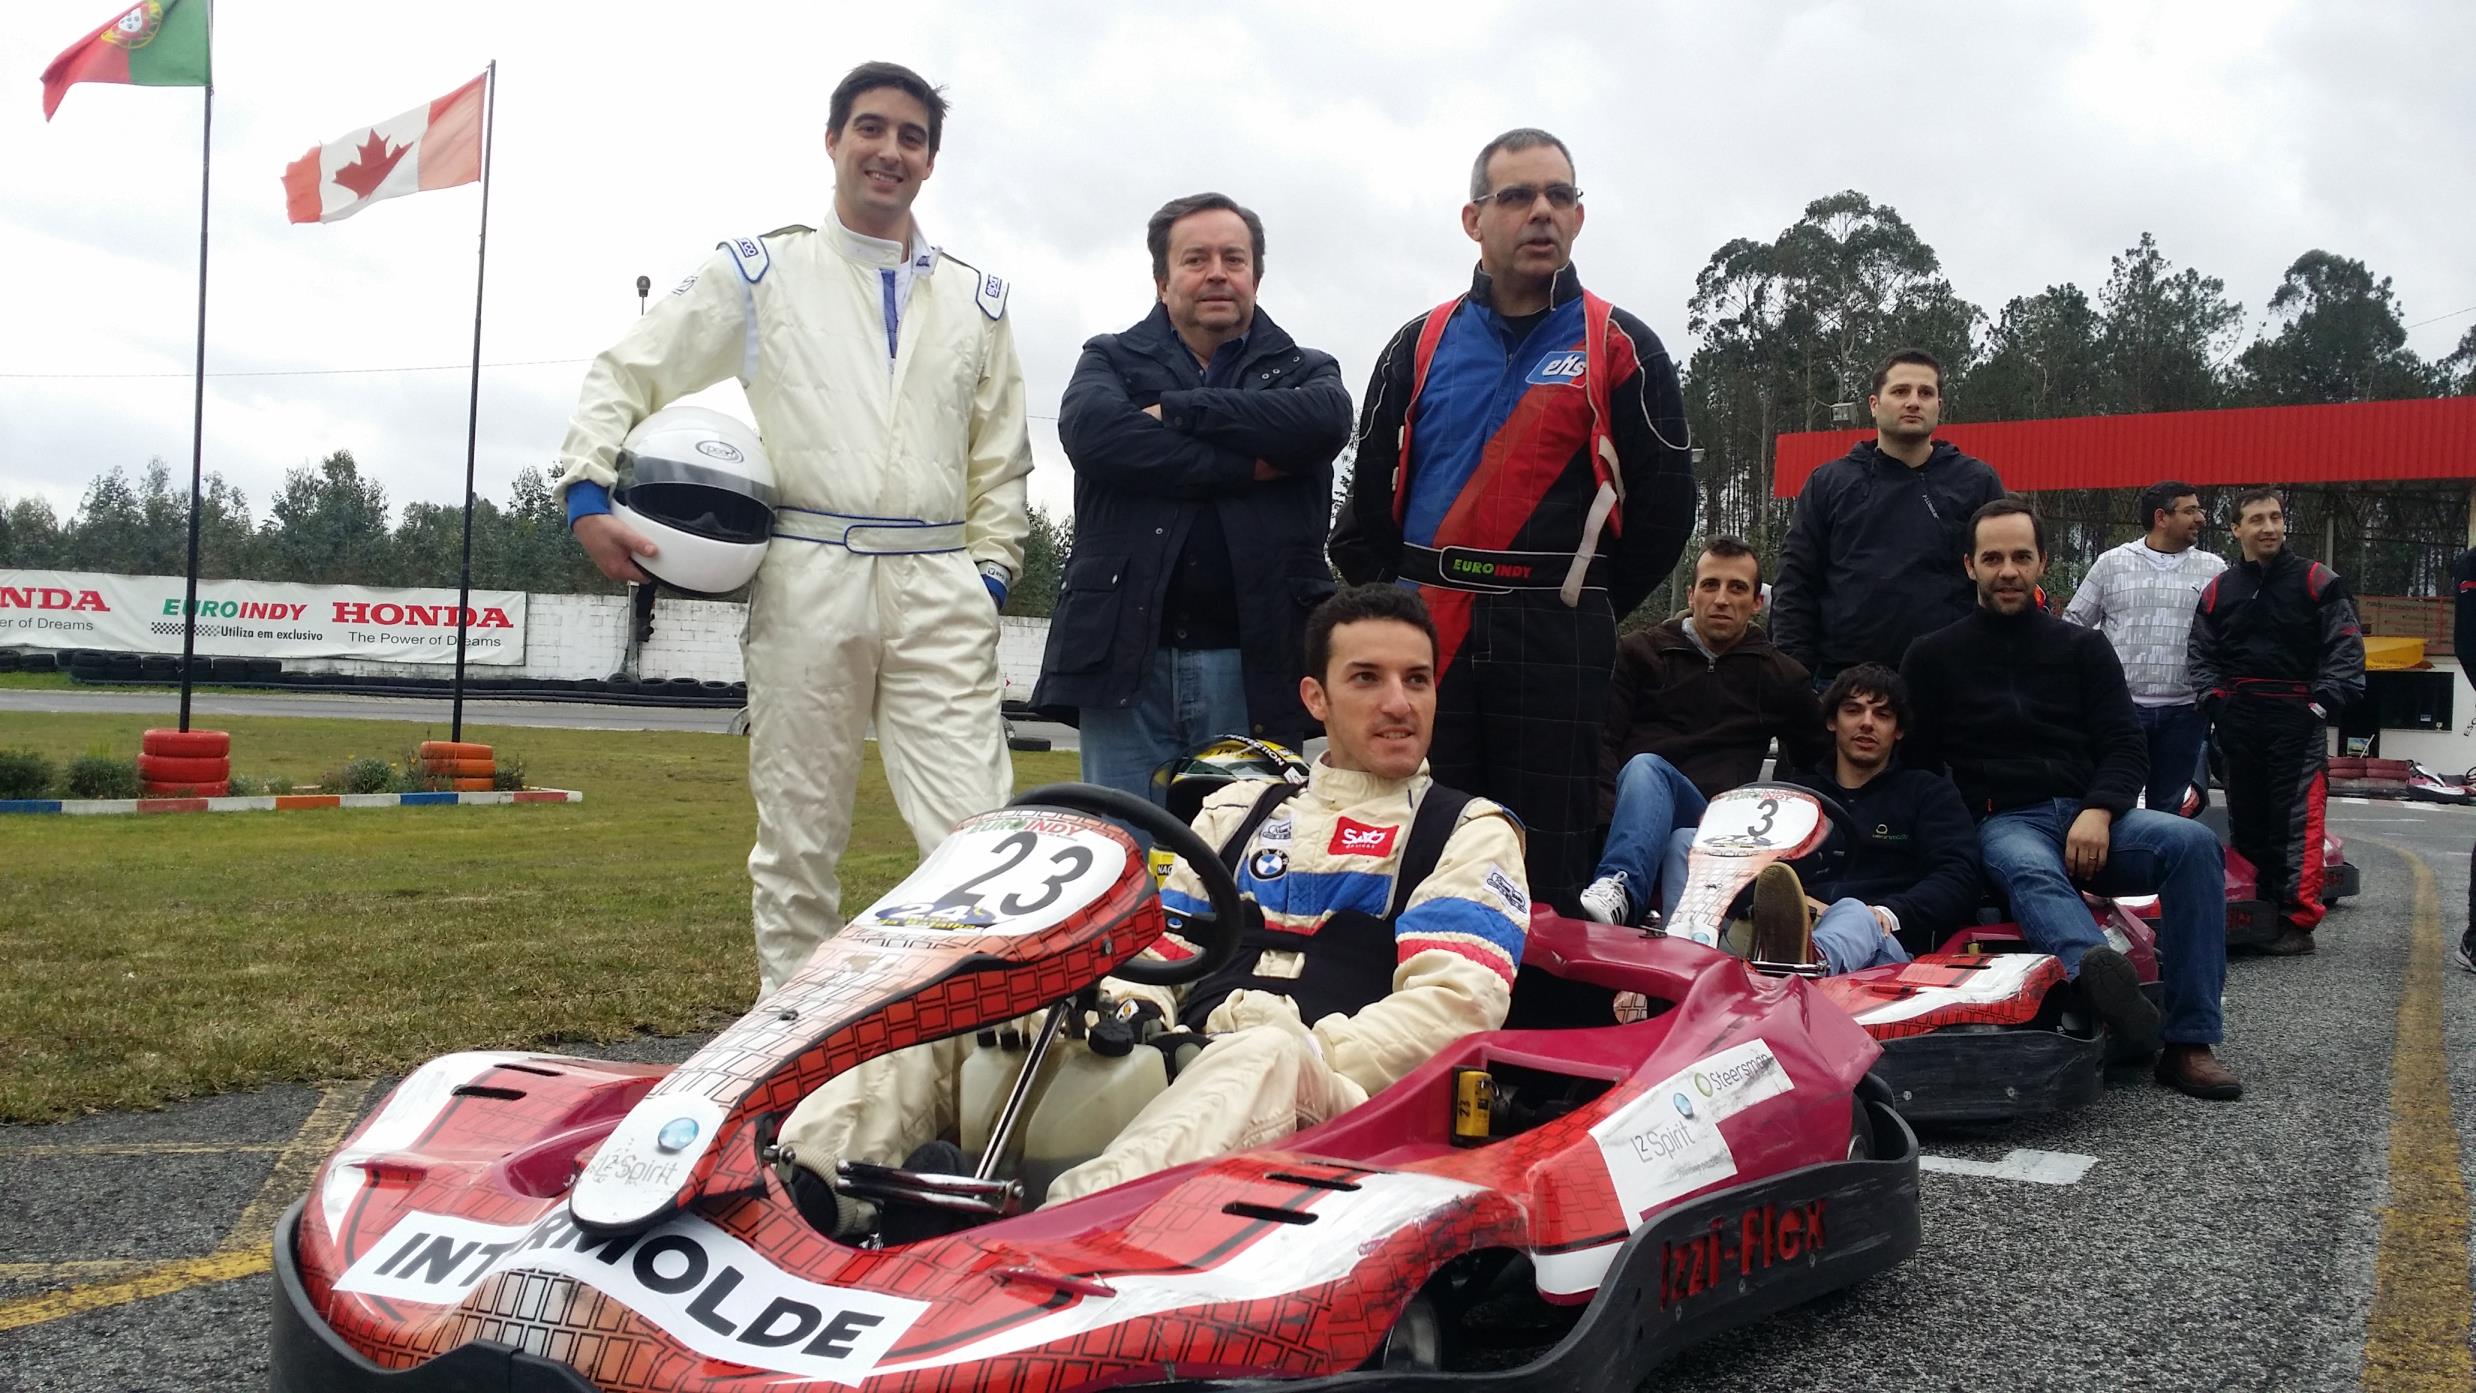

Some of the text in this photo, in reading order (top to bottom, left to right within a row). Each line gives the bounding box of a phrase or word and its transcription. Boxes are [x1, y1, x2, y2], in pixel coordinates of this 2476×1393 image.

[1453, 558, 1533, 578] EUROINDY
[18, 617, 33, 628] of
[37, 617, 94, 631] Dreams
[332, 602, 514, 628] HONDA
[220, 625, 323, 641] Utiliza em exclusivo
[349, 631, 501, 647] The Power of Deams
[1747, 798, 1779, 837] 3
[934, 831, 1094, 916] 23
[373, 1208, 885, 1360] INTRMOLDE
